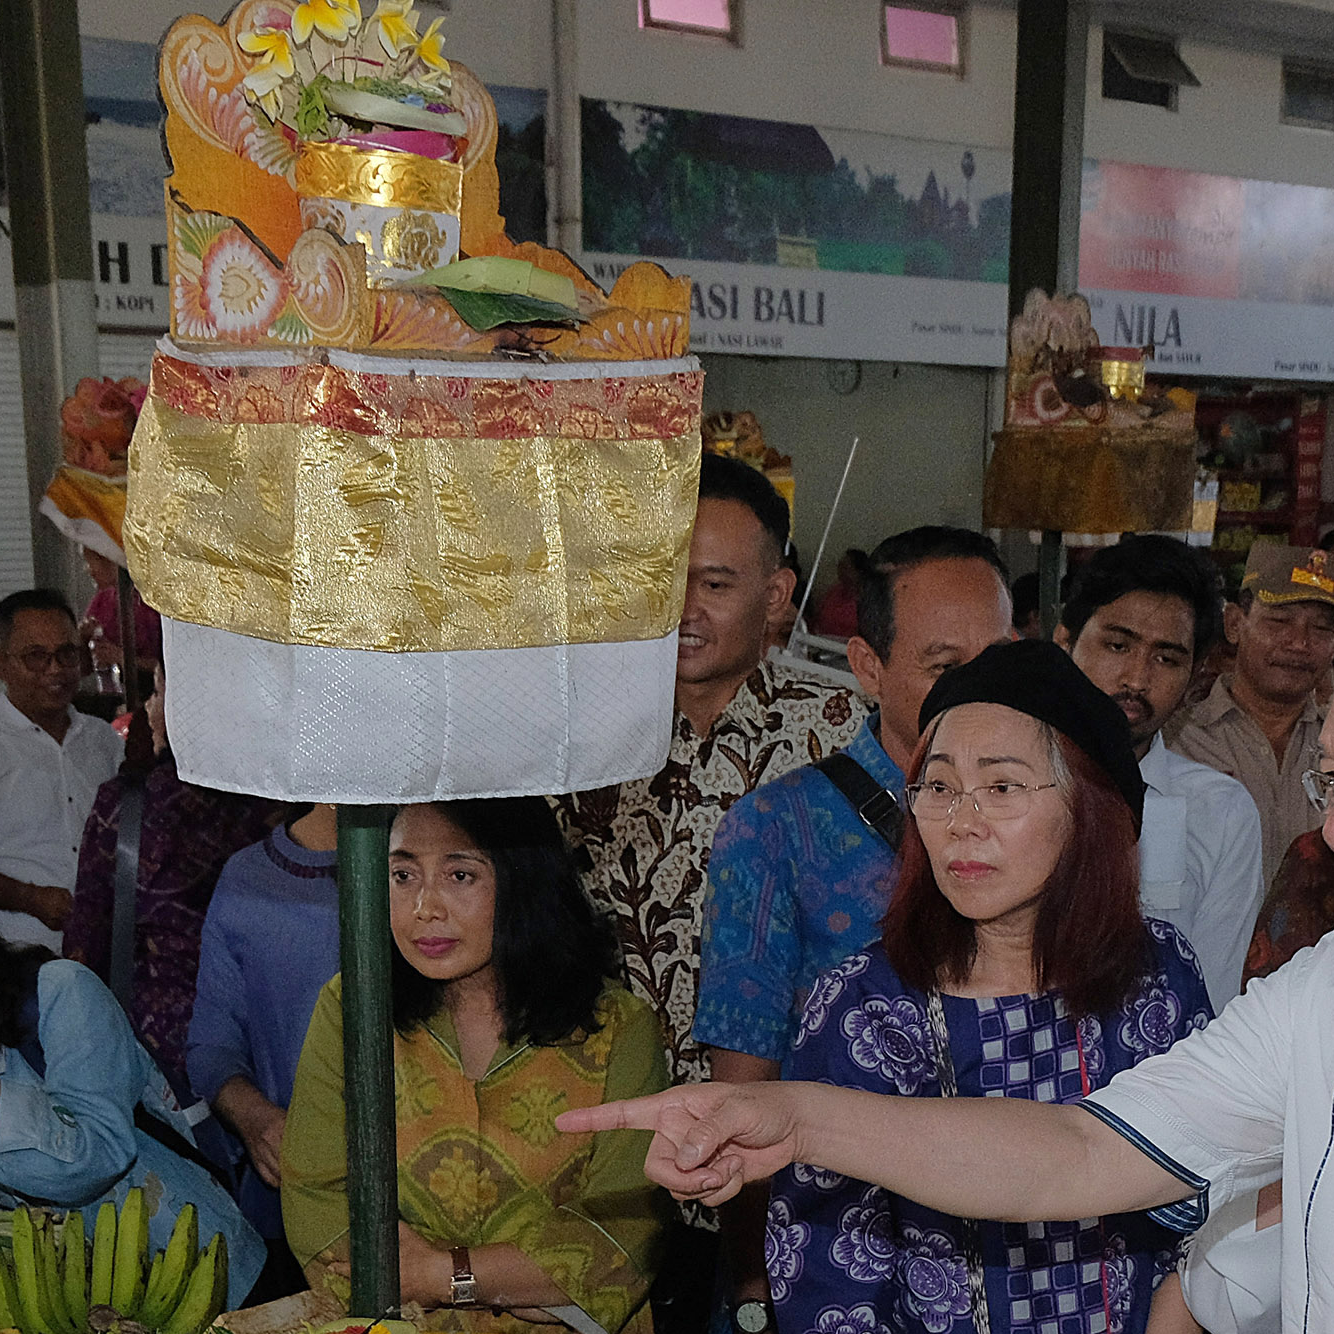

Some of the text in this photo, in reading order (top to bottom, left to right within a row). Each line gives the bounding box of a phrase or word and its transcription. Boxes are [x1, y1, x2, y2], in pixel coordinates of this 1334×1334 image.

[690, 282, 825, 327] ASI BALI
[1115, 304, 1182, 348] NILA
